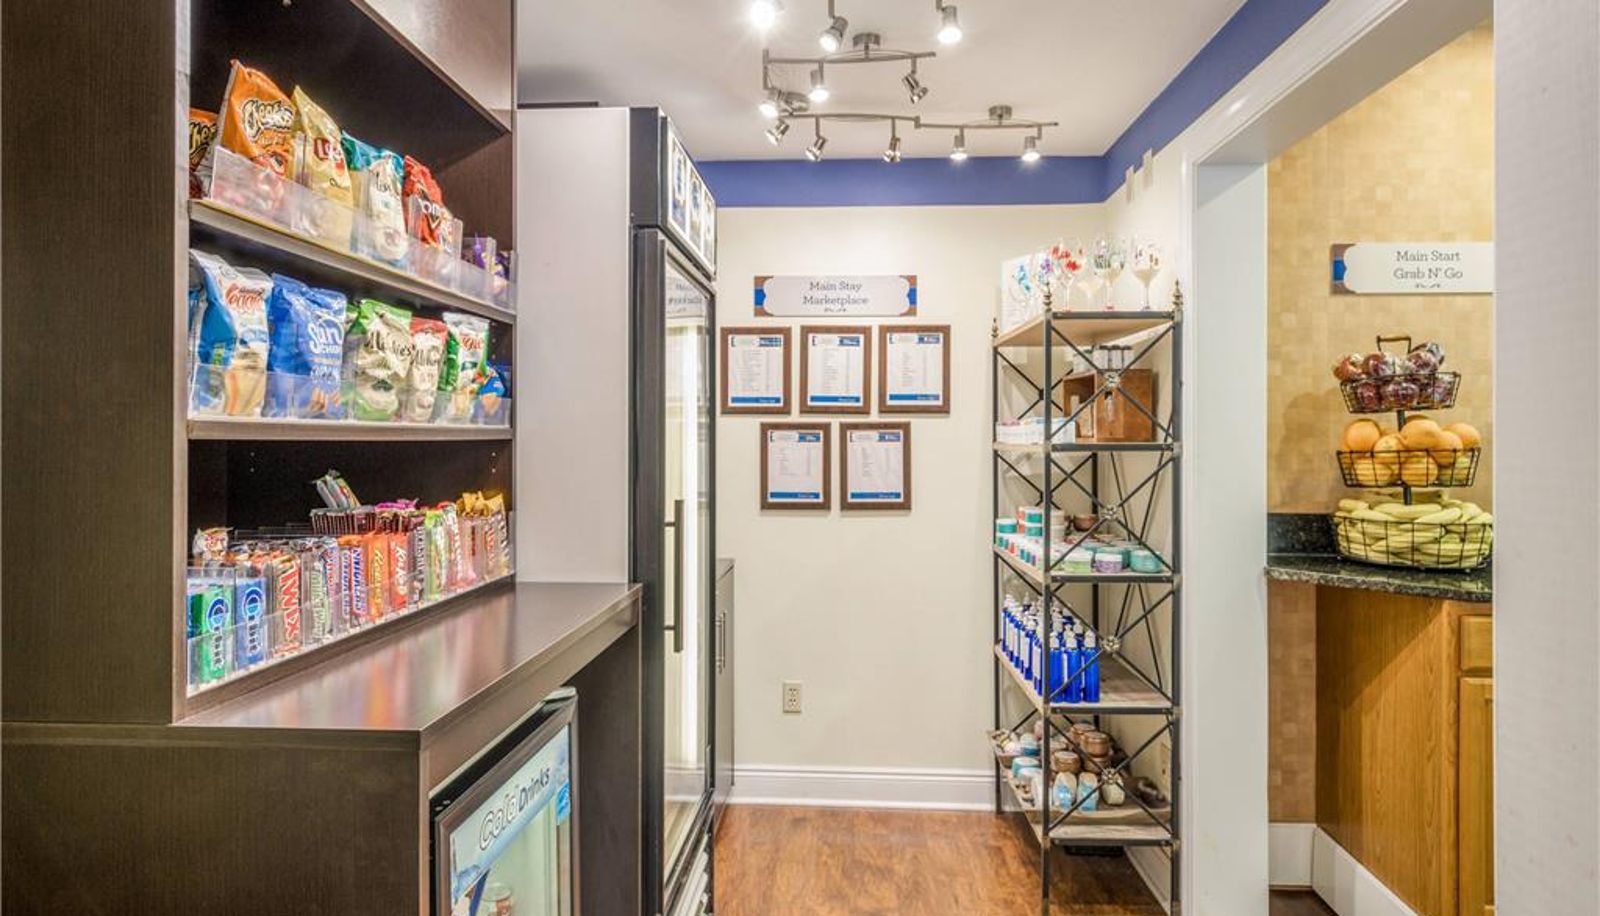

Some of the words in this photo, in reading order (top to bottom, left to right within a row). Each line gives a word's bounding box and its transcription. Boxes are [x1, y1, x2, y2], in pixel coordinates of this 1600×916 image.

[1396, 251, 1428, 262] Main
[1431, 250, 1461, 262] Start
[1393, 268, 1425, 281] Grab
[1428, 268, 1442, 280] N'
[1444, 268, 1464, 280] Go
[809, 281, 837, 291] Main
[839, 280, 862, 293] Stay
[803, 295, 868, 307] Marketplace
[480, 786, 518, 851] Cold
[518, 768, 551, 813] Drinks
